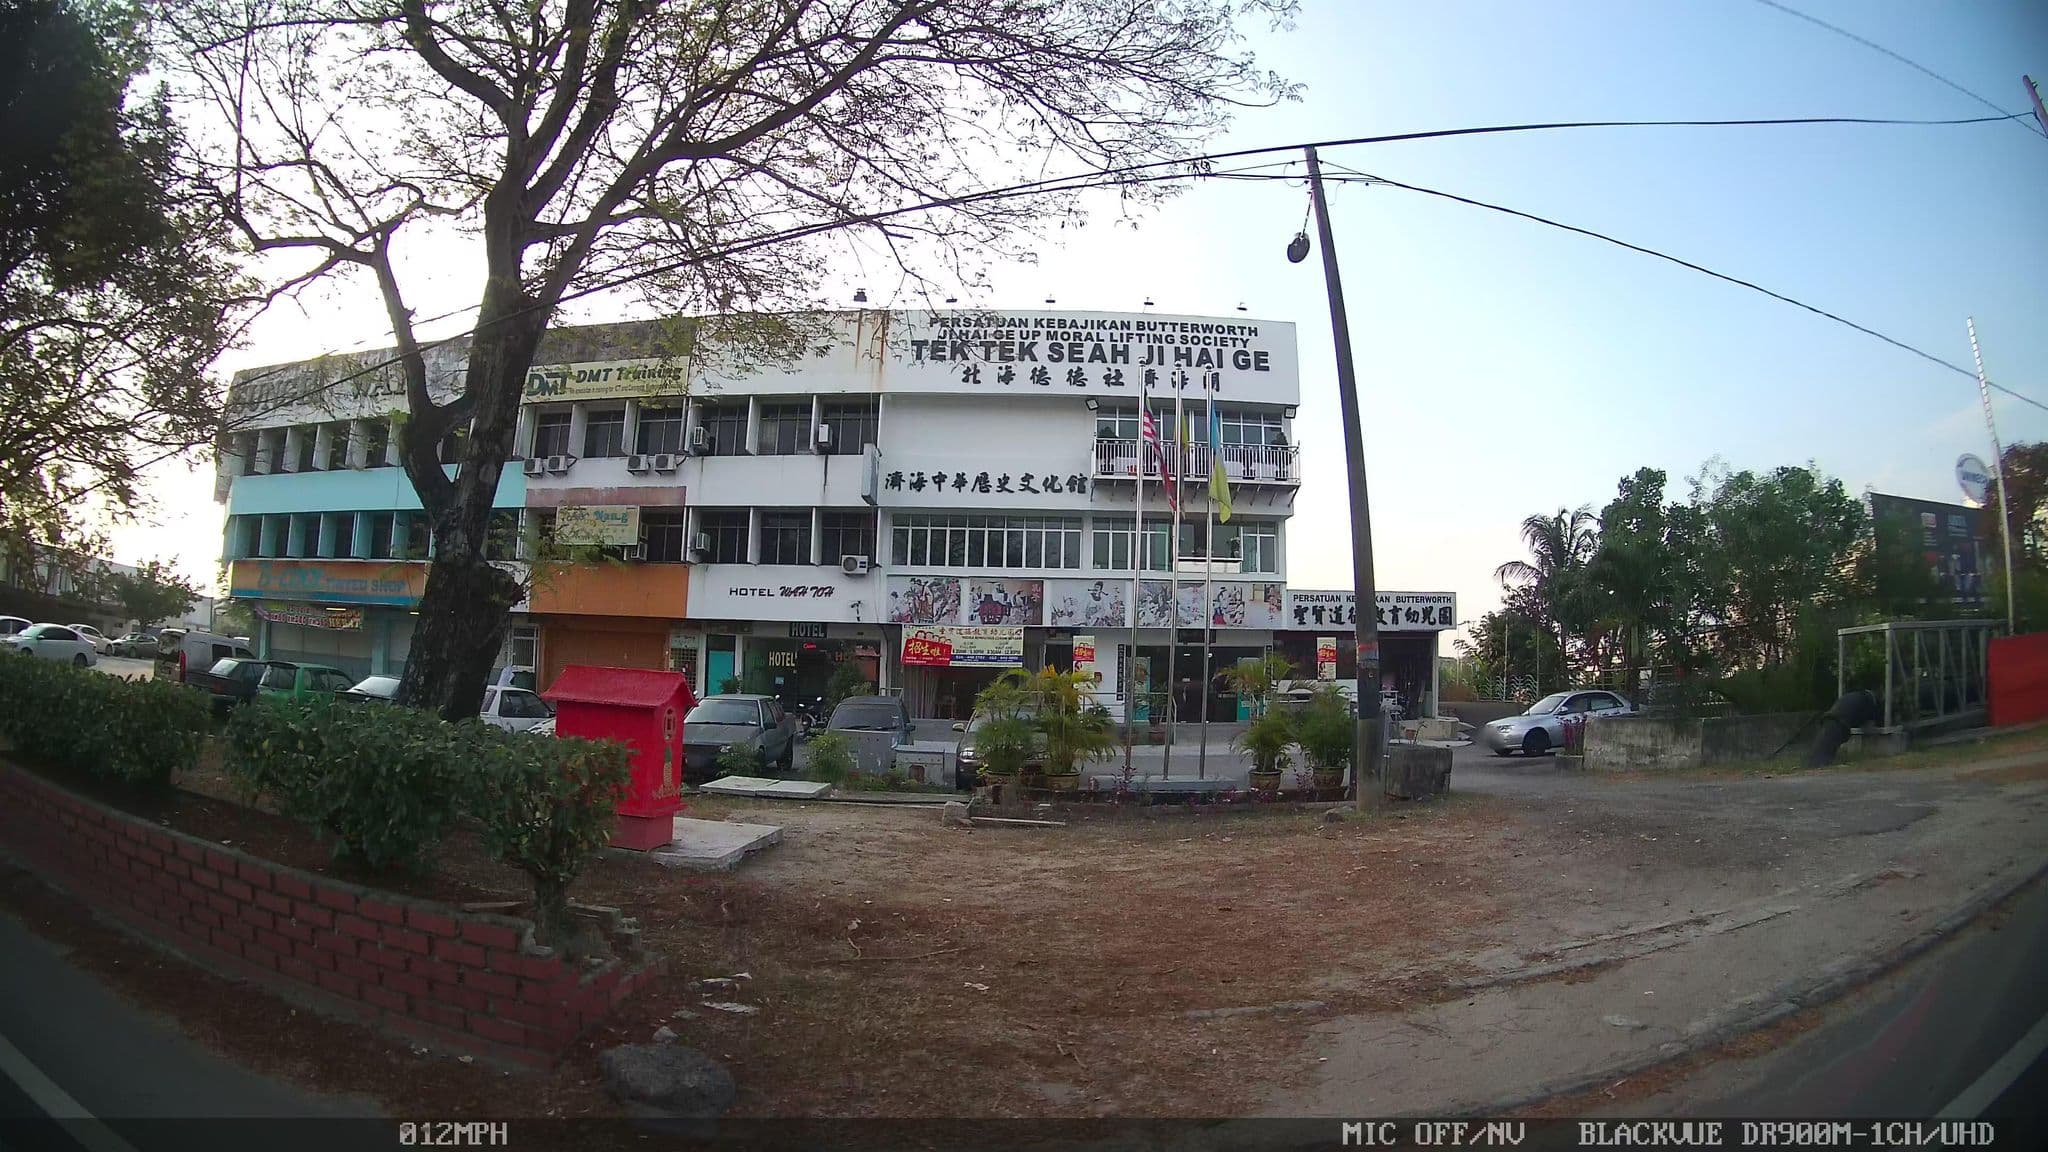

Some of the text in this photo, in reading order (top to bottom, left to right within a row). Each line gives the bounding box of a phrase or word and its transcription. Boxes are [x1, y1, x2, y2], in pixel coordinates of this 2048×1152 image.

[929, 317, 1258, 337] PERSATUAN KEBAJIKAN BUTTERWORTH
[961, 330, 988, 340] HAI
[991, 330, 1015, 340] GE
[1019, 331, 1041, 341] UP
[1046, 331, 1105, 343] MORAL
[1109, 332, 1175, 345] LIFTING
[1180, 335, 1250, 348] SOCIETY
[911, 340, 1270, 372] TEK TEK SEAH JI HAI GE
[575, 368, 613, 384] DMT
[729, 585, 836, 598] HOTEL WAH TOH
[1293, 594, 1341, 603] PERSATUAN
[1396, 595, 1452, 604] BUTTERWORTH
[791, 622, 825, 637] HOTEL
[768, 651, 796, 667] HOTEL
